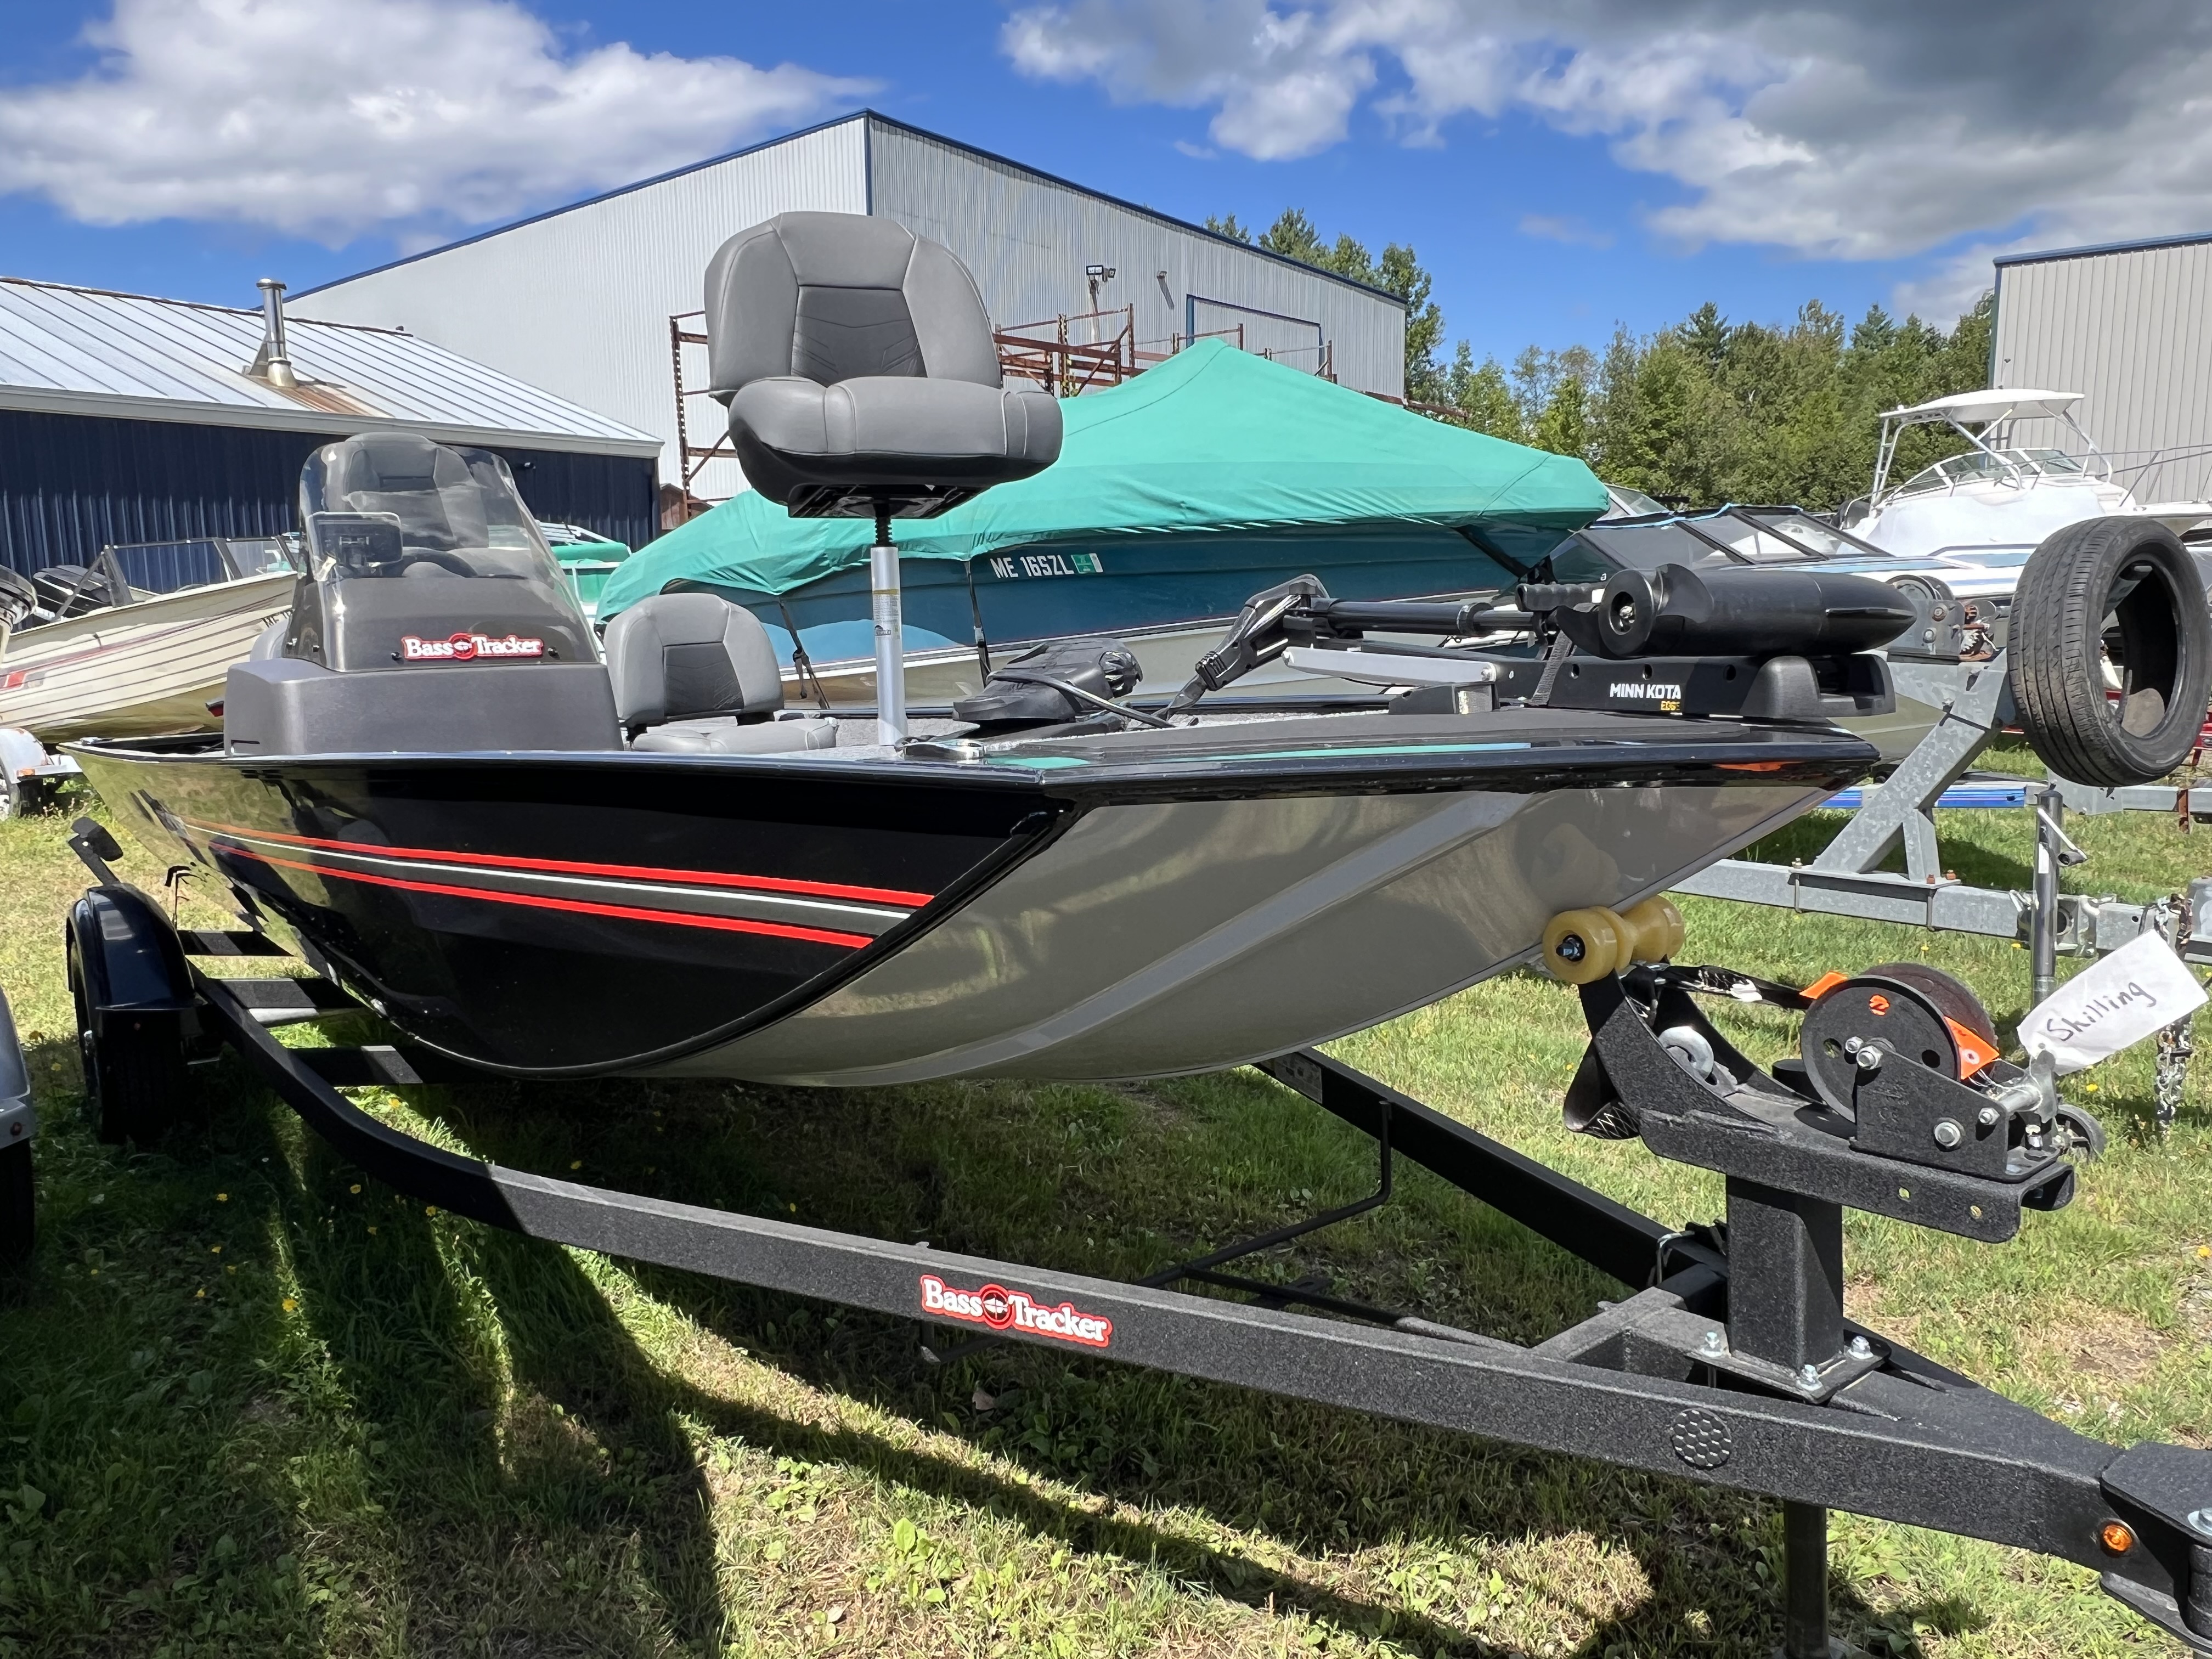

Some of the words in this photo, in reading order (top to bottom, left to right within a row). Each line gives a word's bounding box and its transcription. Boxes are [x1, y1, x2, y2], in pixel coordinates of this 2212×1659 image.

[990, 557, 1019, 579] ME
[405, 639, 454, 657] Bass
[471, 636, 541, 655] Tracker
[1610, 683, 1645, 698] MINN
[1646, 684, 1681, 699] KOTA
[923, 1279, 984, 1317] Bass
[1008, 1294, 1107, 1342] Tracker
